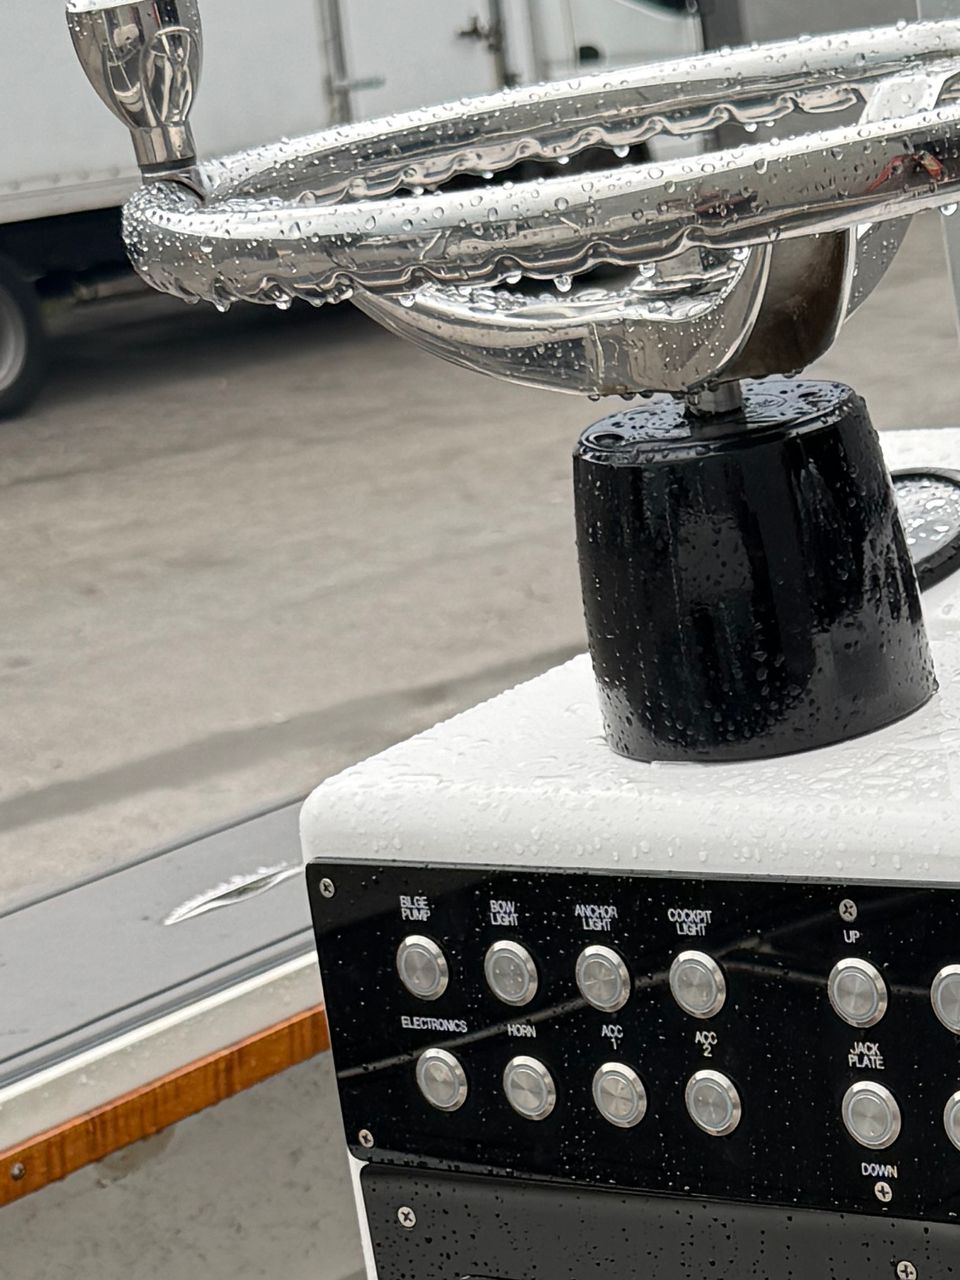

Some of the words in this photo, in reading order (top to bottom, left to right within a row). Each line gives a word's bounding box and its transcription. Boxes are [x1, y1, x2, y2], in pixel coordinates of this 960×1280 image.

[490, 900, 515, 913] BOW
[575, 904, 618, 918] ANCHOR
[401, 908, 430, 921] PUMP
[490, 912, 518, 926] LIGHT
[667, 908, 712, 924] COCKPIT
[582, 917, 612, 931] LIGHT
[676, 921, 707, 936] LIGHT
[843, 930, 860, 943] UP
[401, 1016, 468, 1032] ELECTRONICS
[507, 1024, 537, 1038] HORN
[601, 1025, 623, 1038] ACC
[695, 1031, 718, 1045] ACC
[611, 1037, 617, 1050] 1
[703, 1043, 713, 1057] 2
[850, 1042, 880, 1056] JACK
[848, 1054, 885, 1070] PLATE
[861, 1163, 898, 1179] DOWN
